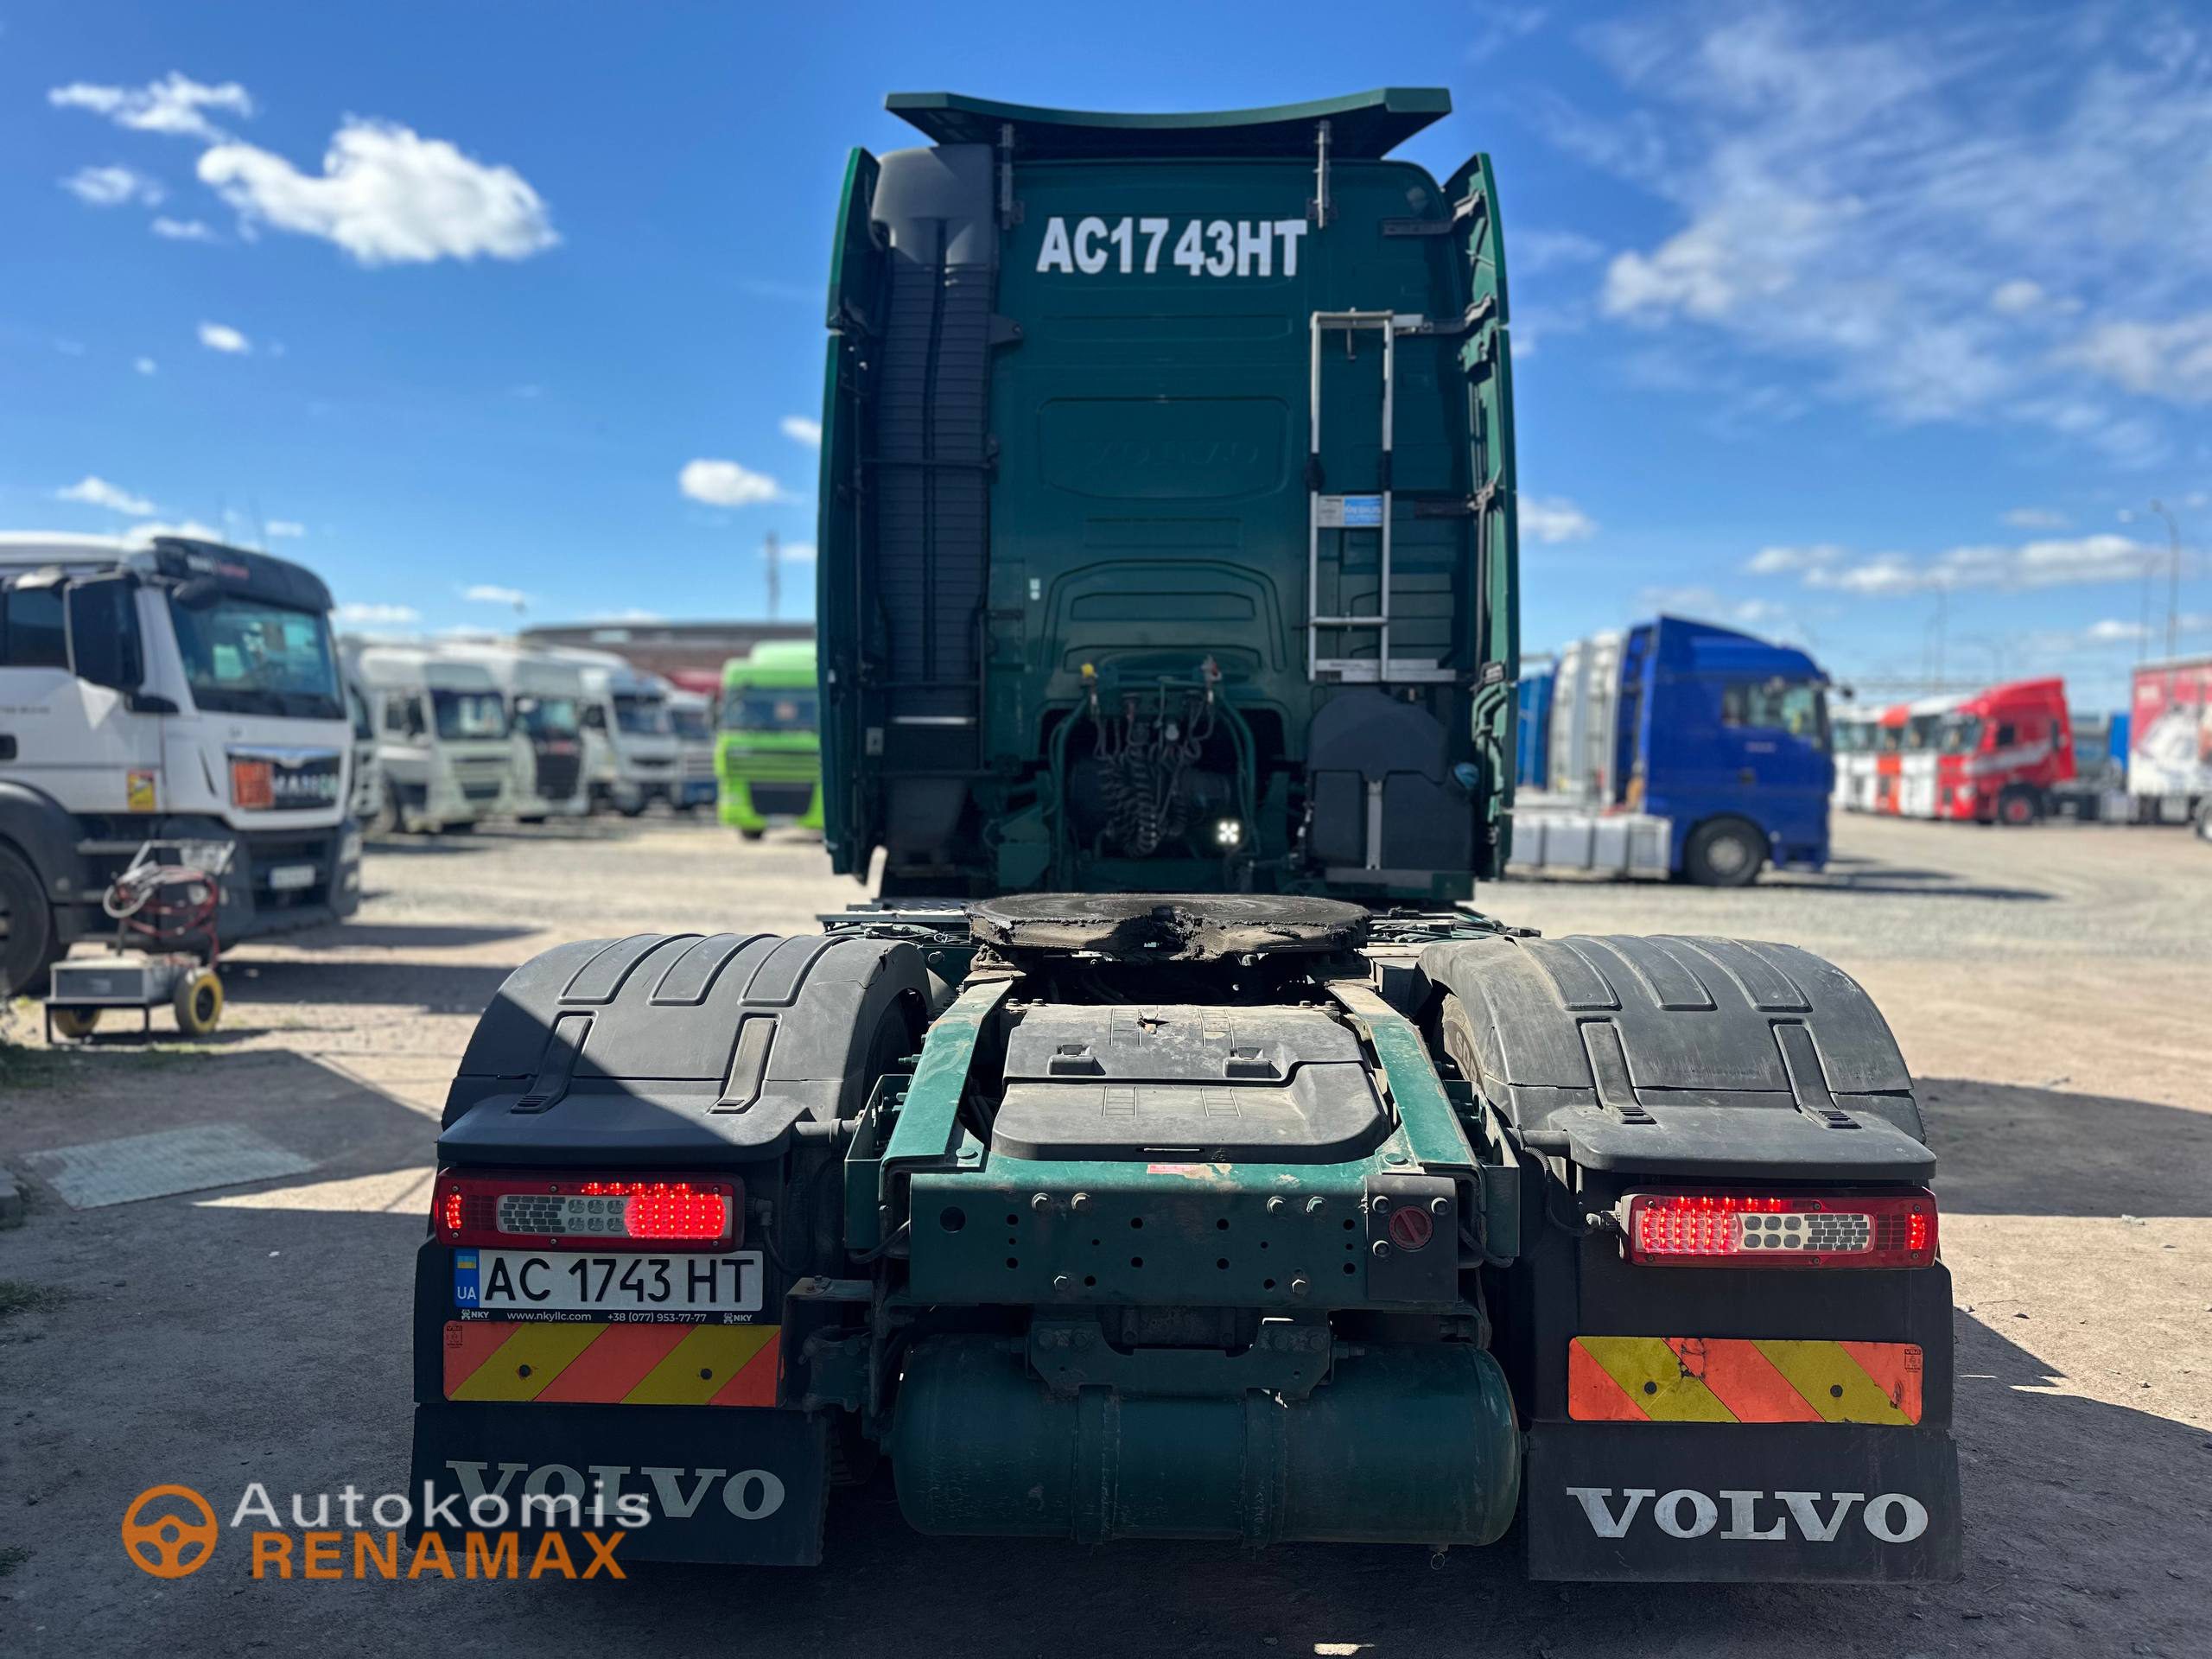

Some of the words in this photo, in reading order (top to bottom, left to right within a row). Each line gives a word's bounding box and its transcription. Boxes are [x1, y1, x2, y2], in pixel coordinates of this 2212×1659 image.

[457, 1286, 477, 1300] UA
[484, 1257, 551, 1302] AC
[568, 1258, 671, 1303] 1743
[687, 1258, 755, 1304] HT
[506, 1312, 592, 1322] www.nkyllc.com
[607, 1313, 626, 1322] +38
[628, 1313, 655, 1323] (077)
[657, 1313, 708, 1323] 953-77-77
[445, 1459, 785, 1520] VOLVO
[1566, 1486, 1929, 1543] VOLVO
